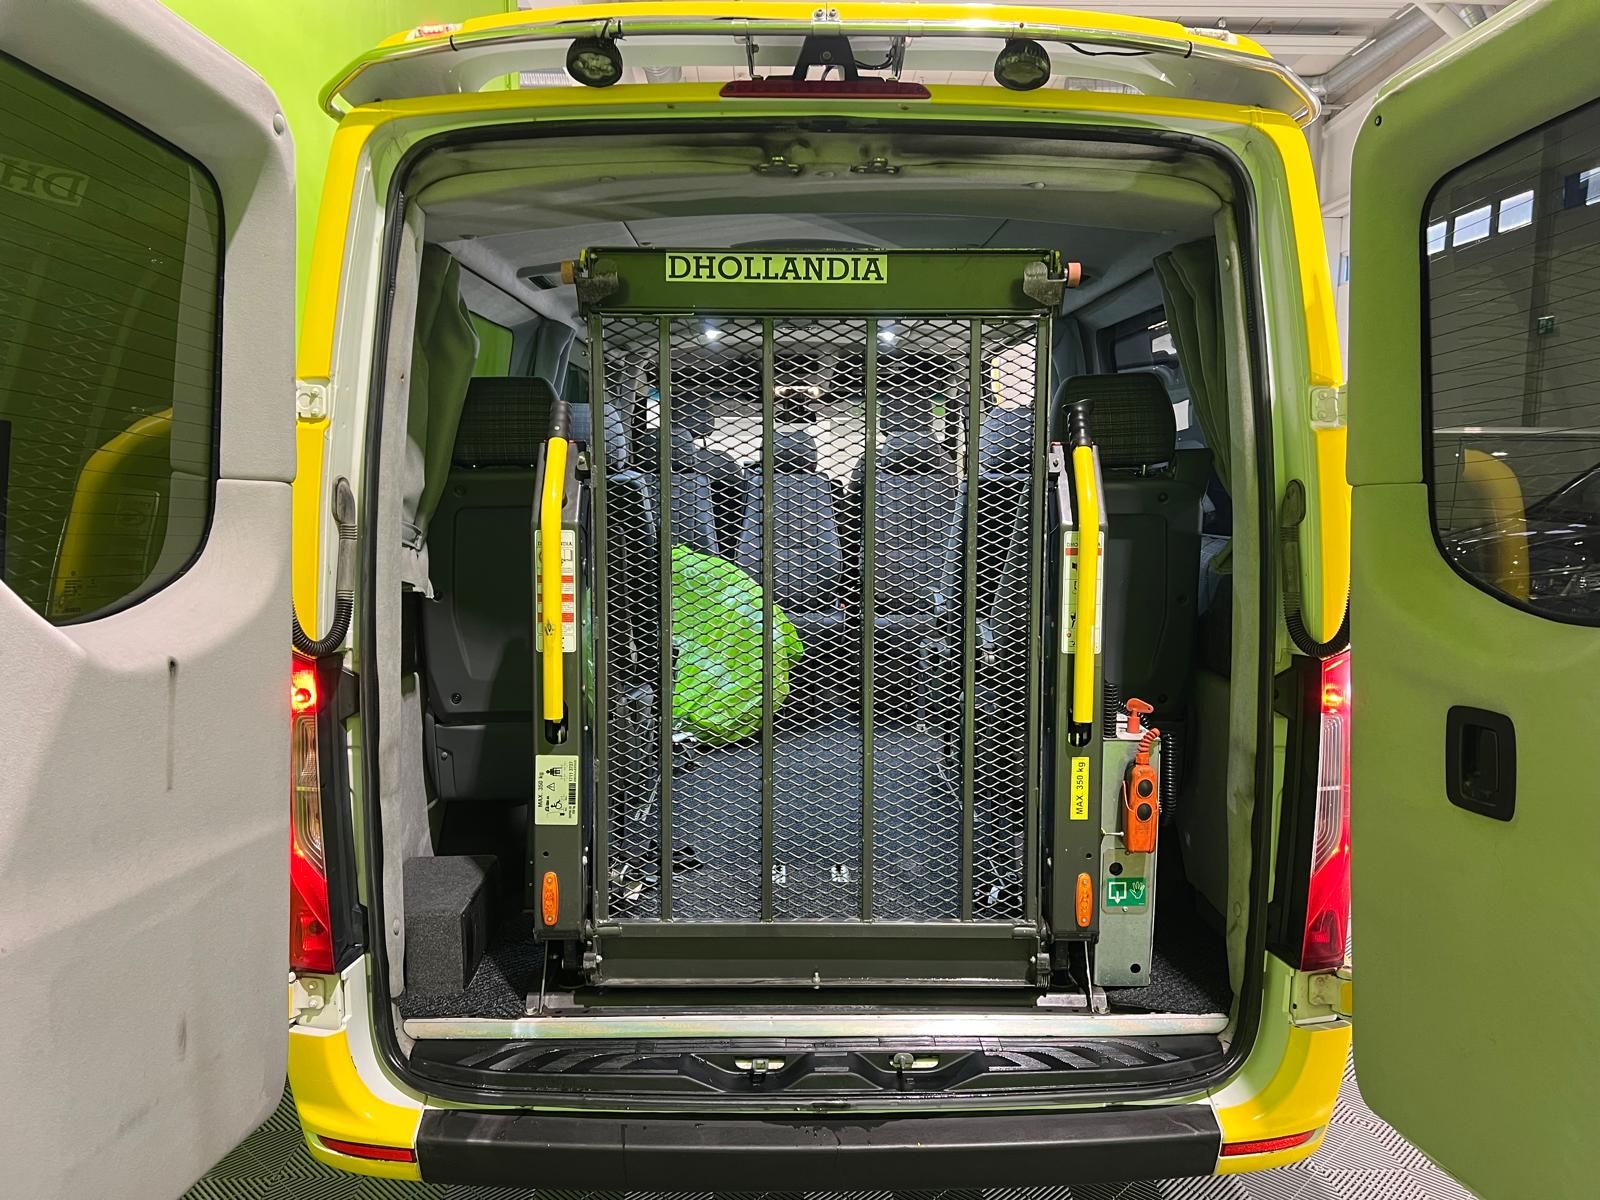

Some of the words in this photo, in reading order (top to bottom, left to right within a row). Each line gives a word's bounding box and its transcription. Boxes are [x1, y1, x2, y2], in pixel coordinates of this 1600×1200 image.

[668, 255, 884, 281] DHOLLANDIA
[1076, 762, 1086, 773] kg
[538, 771, 544, 779] kg
[1076, 775, 1084, 790] 350
